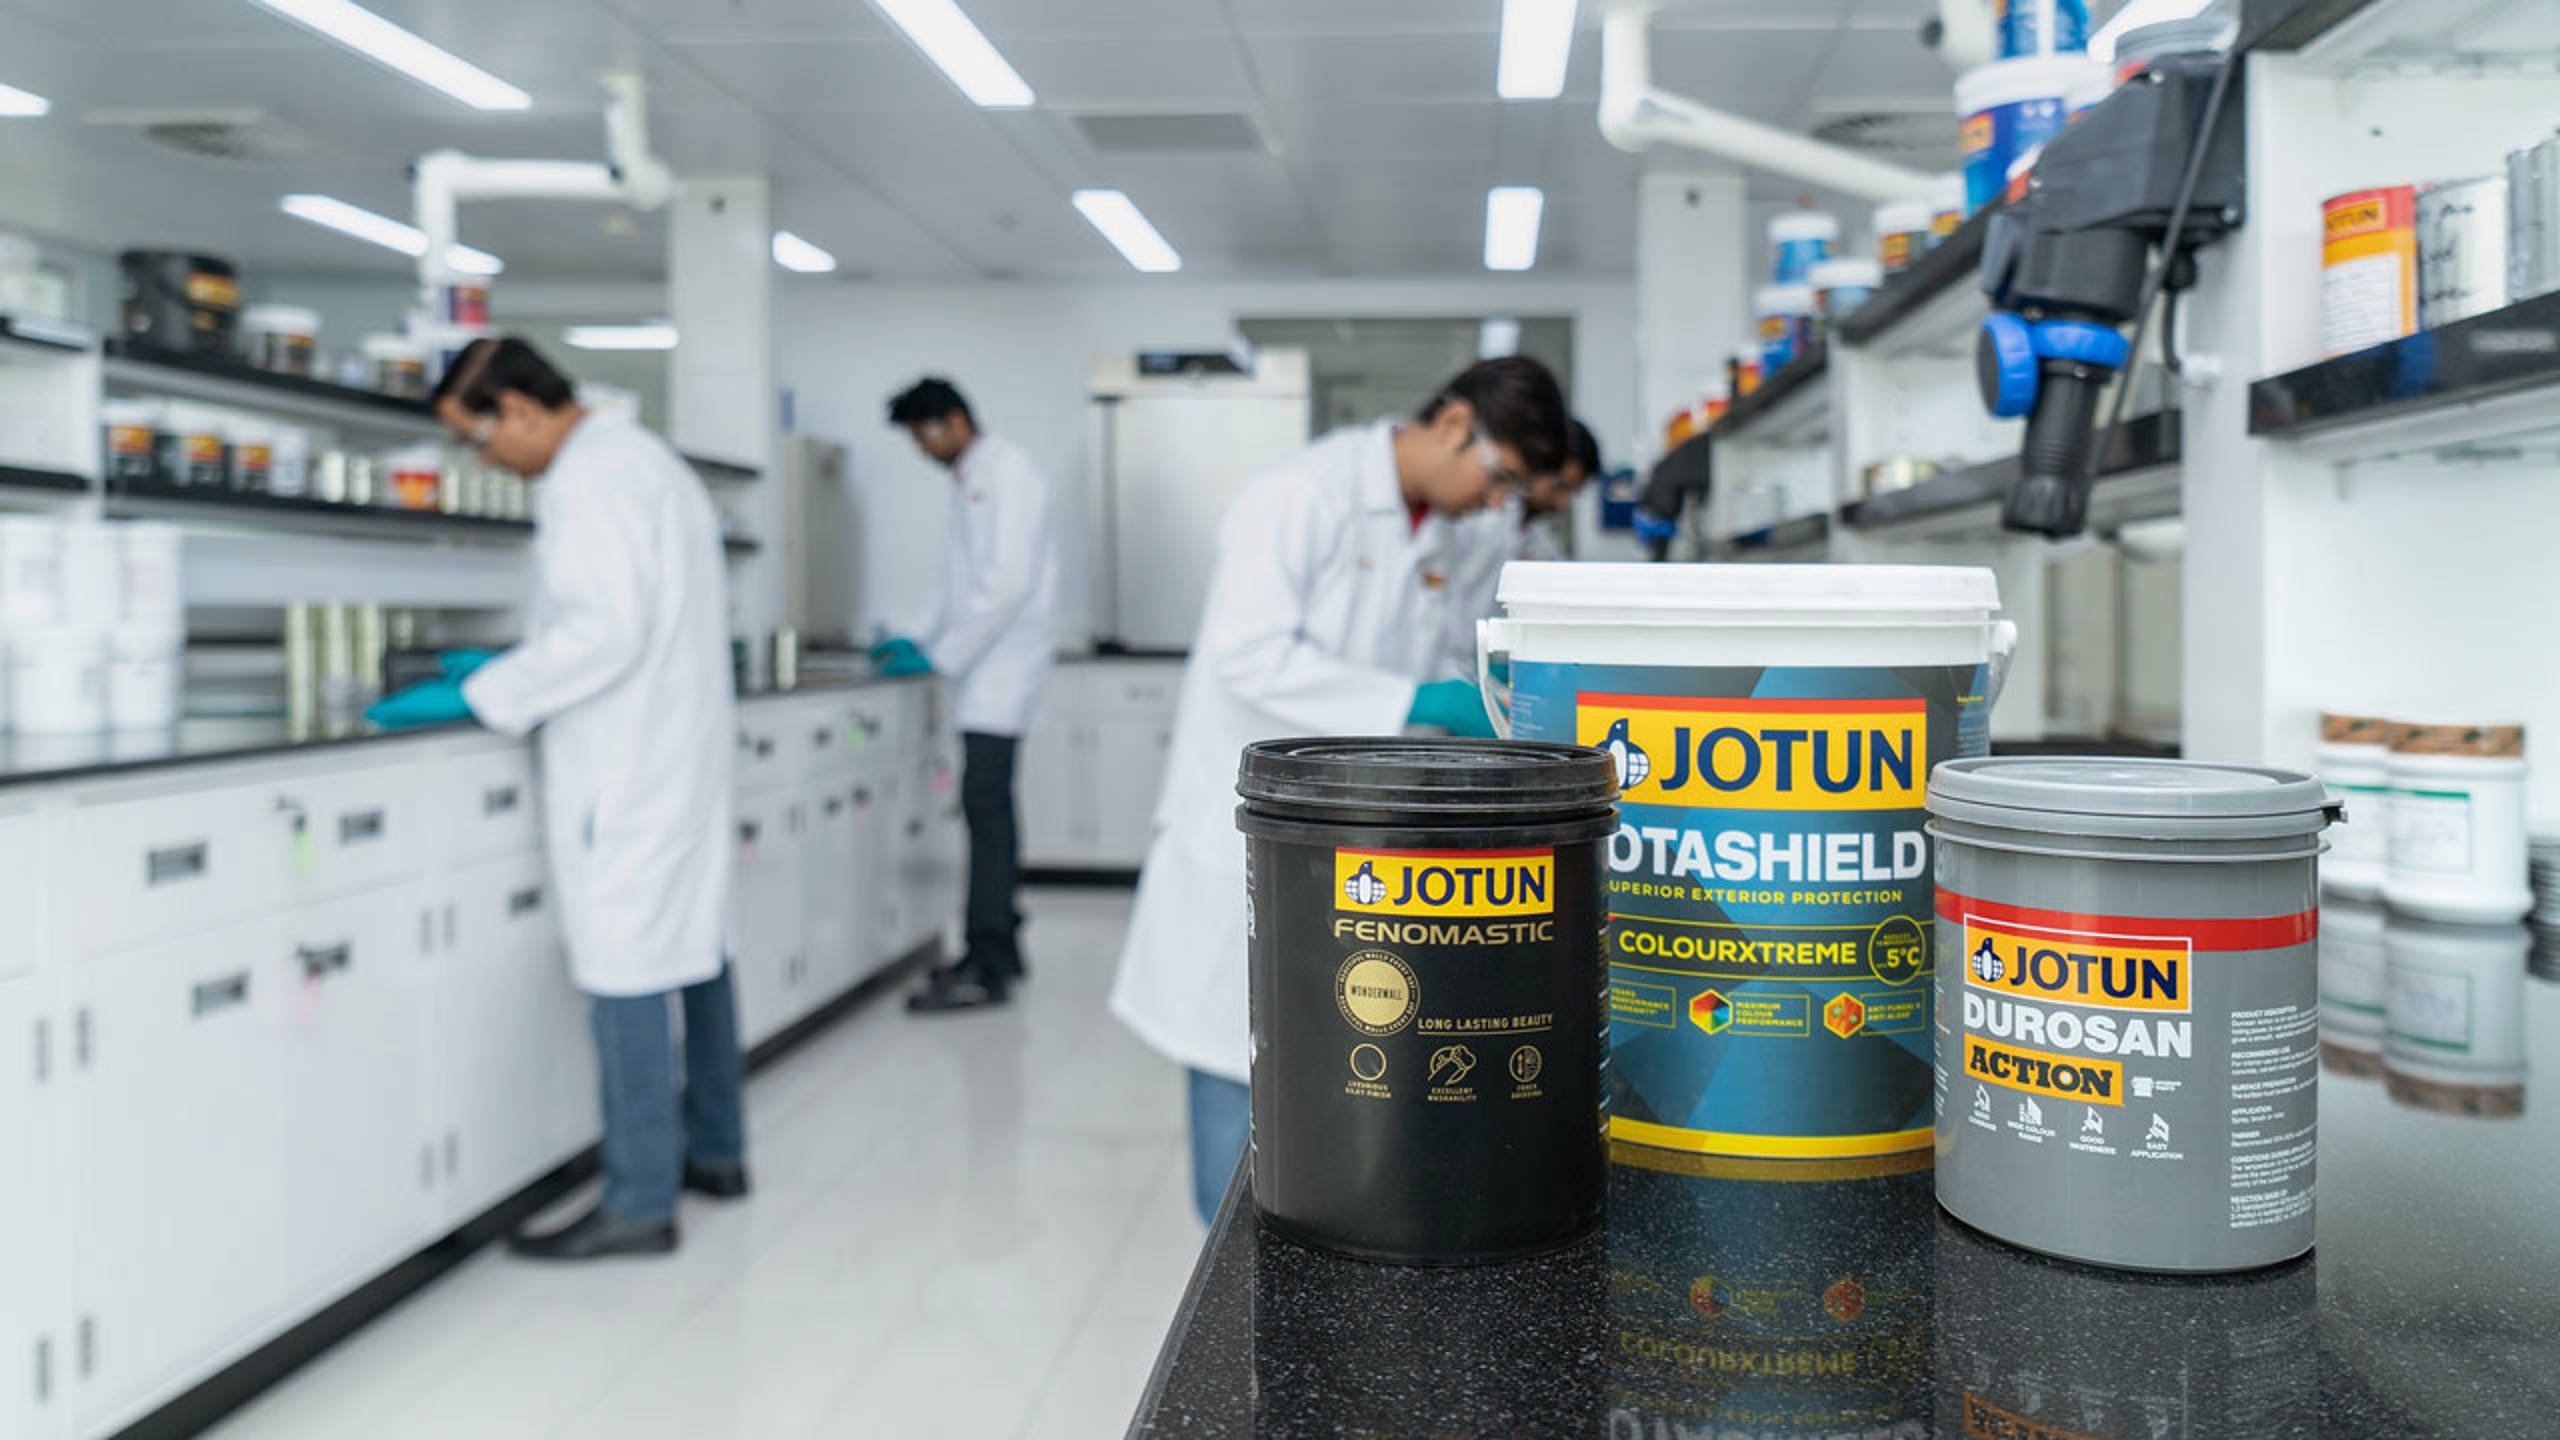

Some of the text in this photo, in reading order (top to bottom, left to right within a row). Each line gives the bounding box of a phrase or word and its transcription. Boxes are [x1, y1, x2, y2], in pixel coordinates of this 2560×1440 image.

[1659, 726, 1913, 793] JOTUN
[1608, 823, 1927, 881] OTASHIELD
[1393, 865, 1546, 906] JOTUN
[1609, 880, 1903, 906] UPERIOR EXTERIOR PROTECTION
[1333, 918, 1553, 945] FENOMASTIC
[1618, 930, 1857, 965] COLOURXTREME
[1887, 946, 1920, 968] 5°C
[2009, 946, 2178, 1000] JOTUN
[1351, 984, 1403, 1001] WONDERWALL
[1417, 1013, 1553, 1031] LONG LASTING BEAUTY
[1964, 991, 2192, 1058] DUROSAN
[1970, 1045, 2113, 1097] ACTION
[2130, 1150, 2184, 1160] APPLICATION
[2146, 1142, 2167, 1151] EASY
